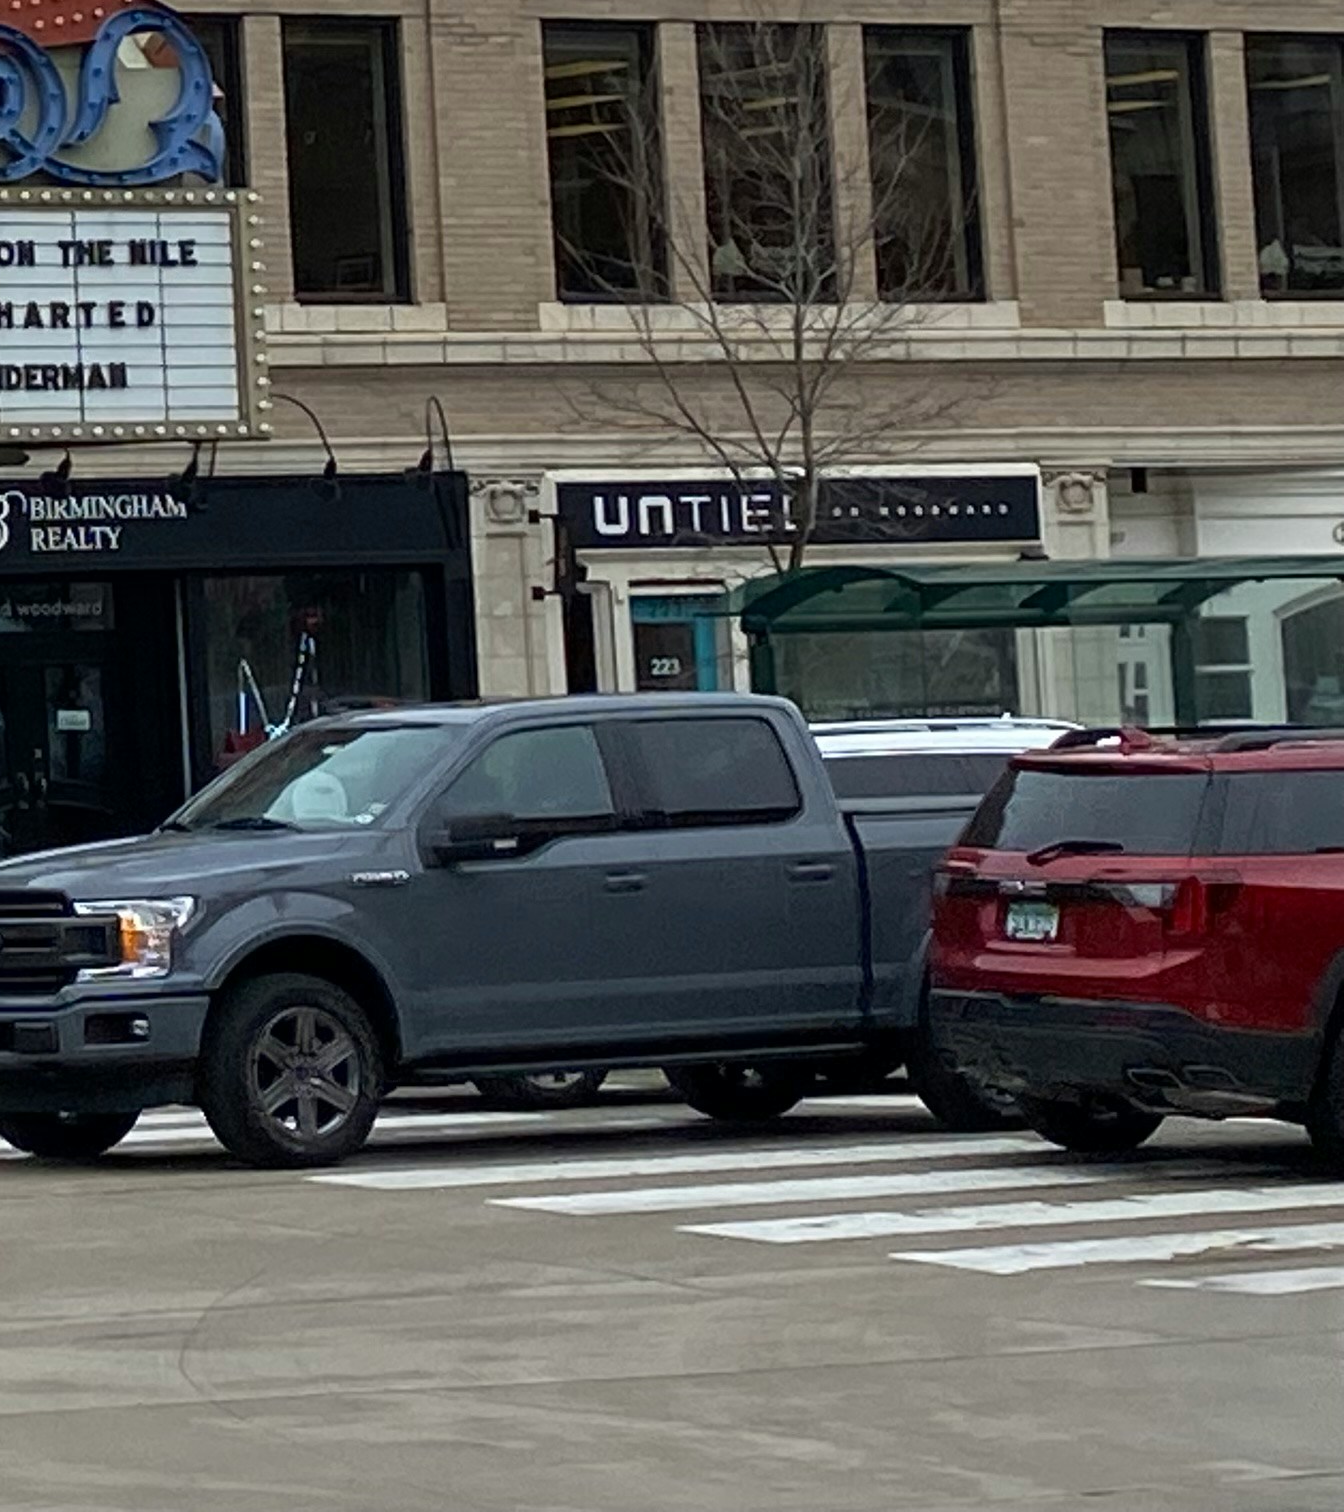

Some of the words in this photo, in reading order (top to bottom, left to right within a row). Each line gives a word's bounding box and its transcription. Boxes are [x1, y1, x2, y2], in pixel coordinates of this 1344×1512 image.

[58, 239, 115, 267] THE
[129, 239, 198, 267] NILE
[29, 494, 187, 522] BIRMINGHAM
[30, 526, 123, 552] REALTY
[650, 657, 680, 677] 223
